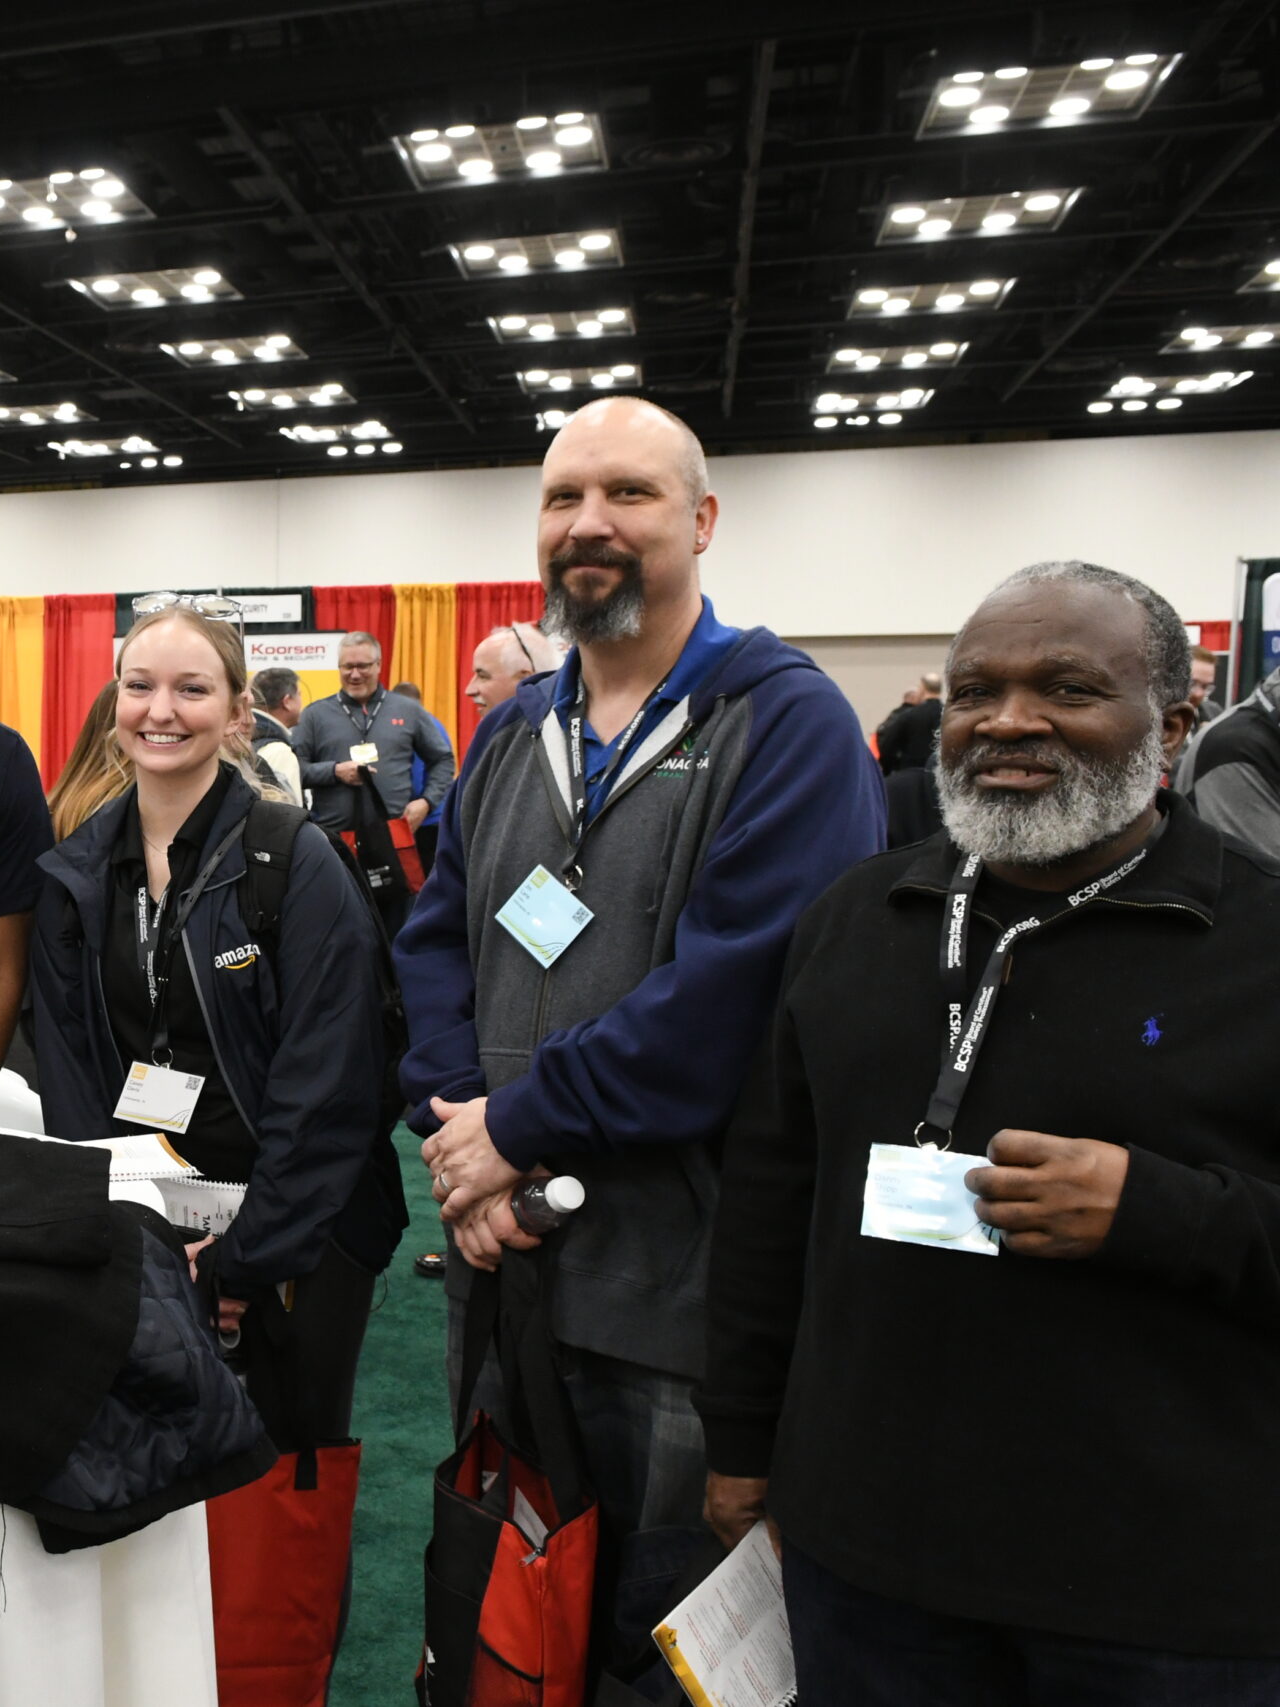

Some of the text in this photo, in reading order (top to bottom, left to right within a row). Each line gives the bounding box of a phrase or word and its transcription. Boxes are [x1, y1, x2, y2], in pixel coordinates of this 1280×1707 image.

[243, 604, 268, 613] CURITY
[251, 644, 326, 655] Koorsen
[571, 717, 580, 737] BCSP
[962, 853, 980, 877] SP.ORG
[138, 887, 146, 905] BCSP
[952, 894, 967, 918] BCSP
[1067, 882, 1100, 907] BCSP
[996, 916, 1040, 952] BCSP.ORG
[953, 1039, 973, 1072] BCSP
